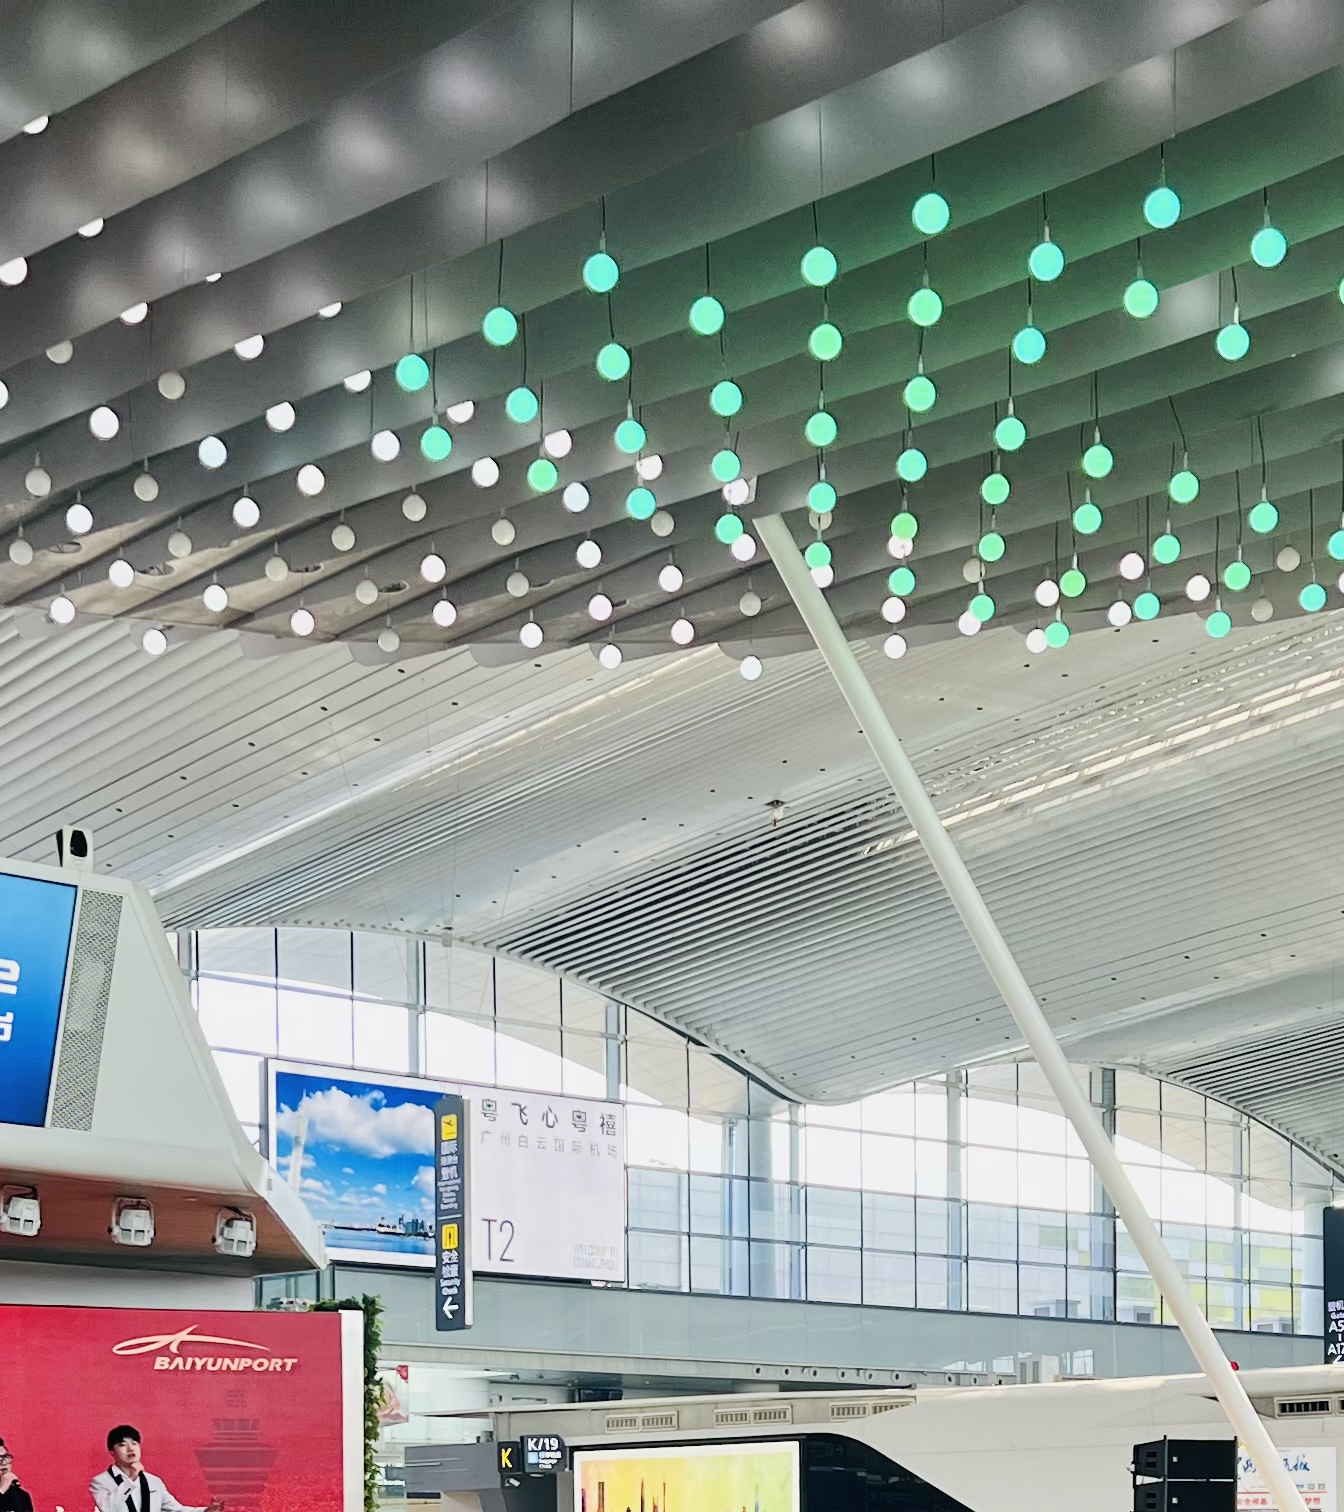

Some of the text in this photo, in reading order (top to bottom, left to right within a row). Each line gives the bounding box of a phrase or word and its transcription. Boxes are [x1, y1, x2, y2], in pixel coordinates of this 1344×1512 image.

[481, 1130, 618, 1158] 广州白云国际机场
[481, 1218, 515, 1262] T2
[153, 1356, 299, 1372] BAIYUNPORT
[527, 1437, 559, 1451] K/19
[501, 1447, 513, 1469] K
